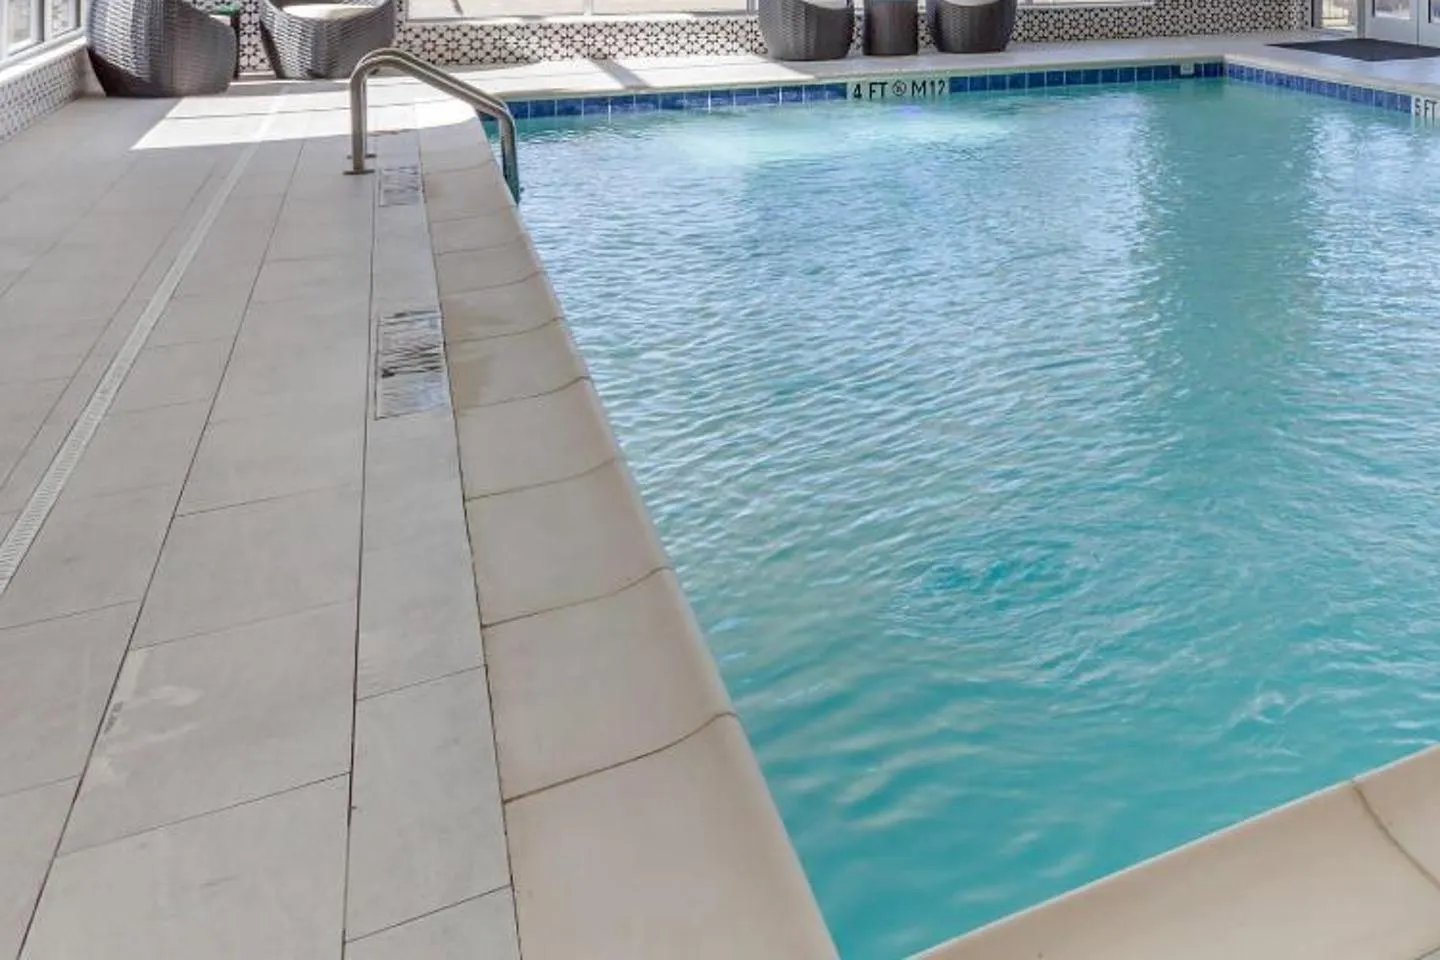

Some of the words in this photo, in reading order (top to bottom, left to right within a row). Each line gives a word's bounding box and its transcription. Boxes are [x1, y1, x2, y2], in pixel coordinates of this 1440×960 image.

[853, 83, 863, 99] 4
[868, 81, 888, 100] FT
[1424, 99, 1438, 121] FT
